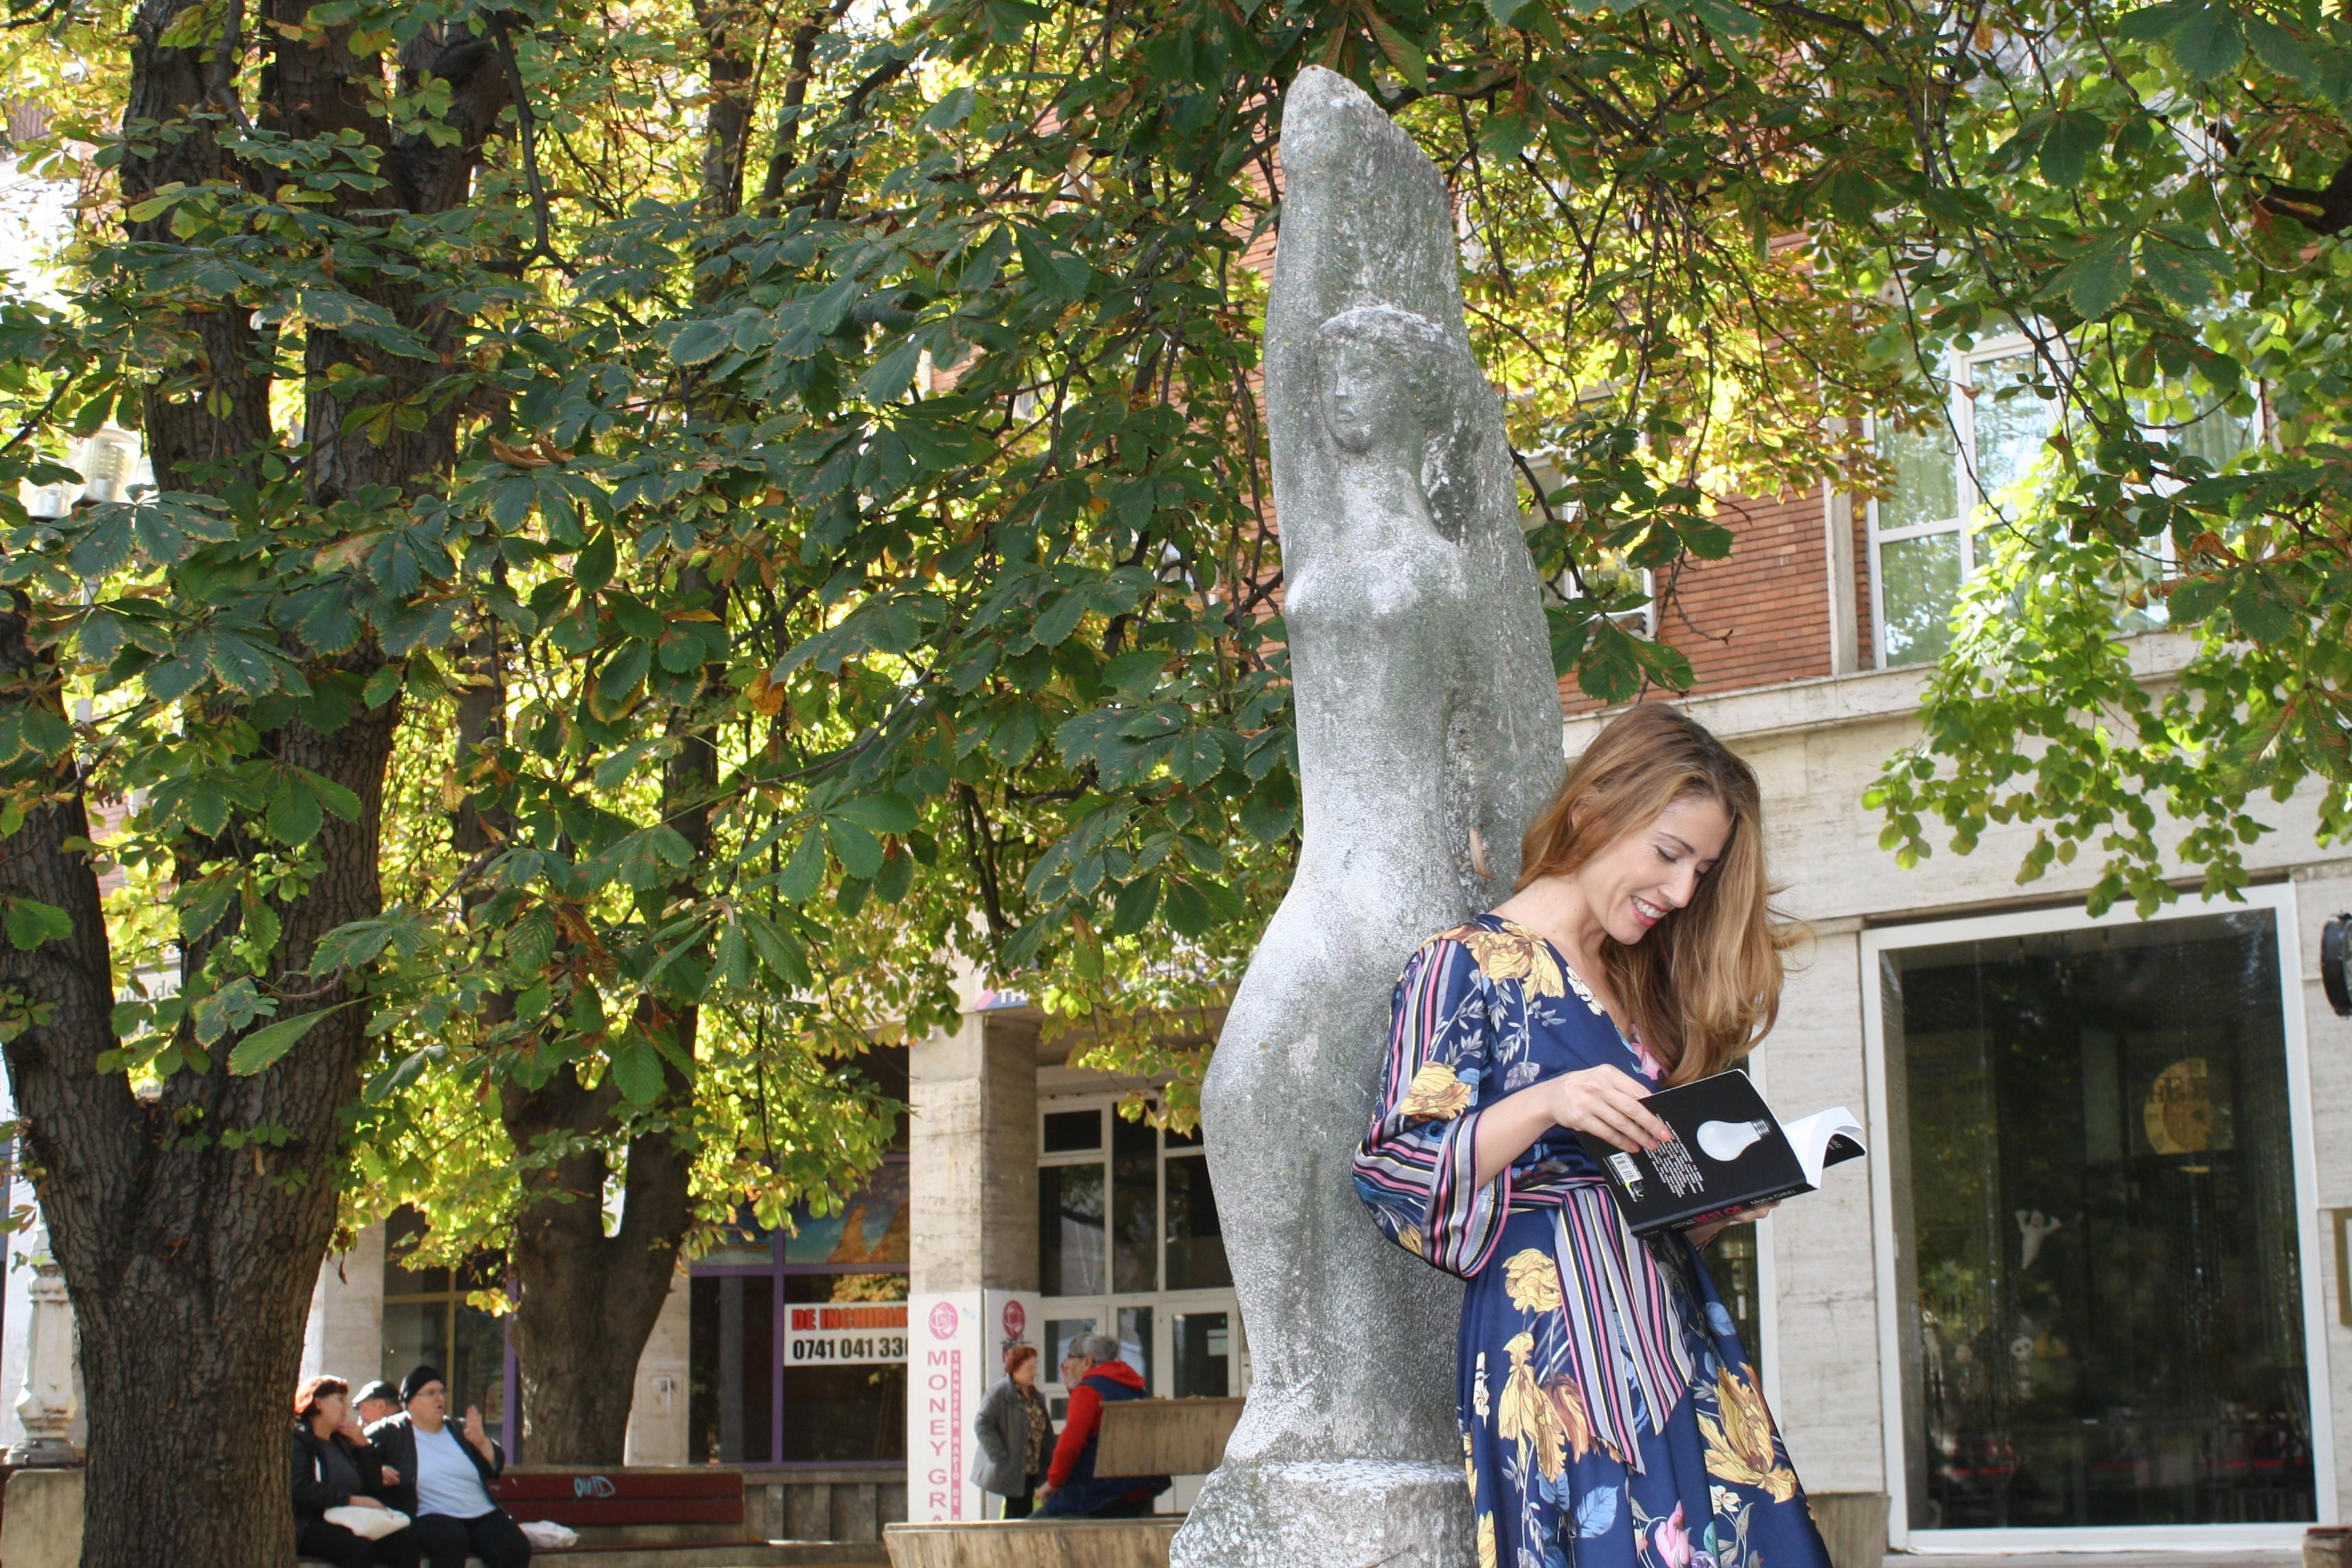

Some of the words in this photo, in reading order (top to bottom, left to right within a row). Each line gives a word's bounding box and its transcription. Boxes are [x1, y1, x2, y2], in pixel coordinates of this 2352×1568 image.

[792, 1309, 816, 1330] DE
[820, 1306, 908, 1330] INCHIRIA
[793, 1339, 835, 1360] 0741
[840, 1338, 873, 1358] 041
[928, 1350, 948, 1456] MONEY
